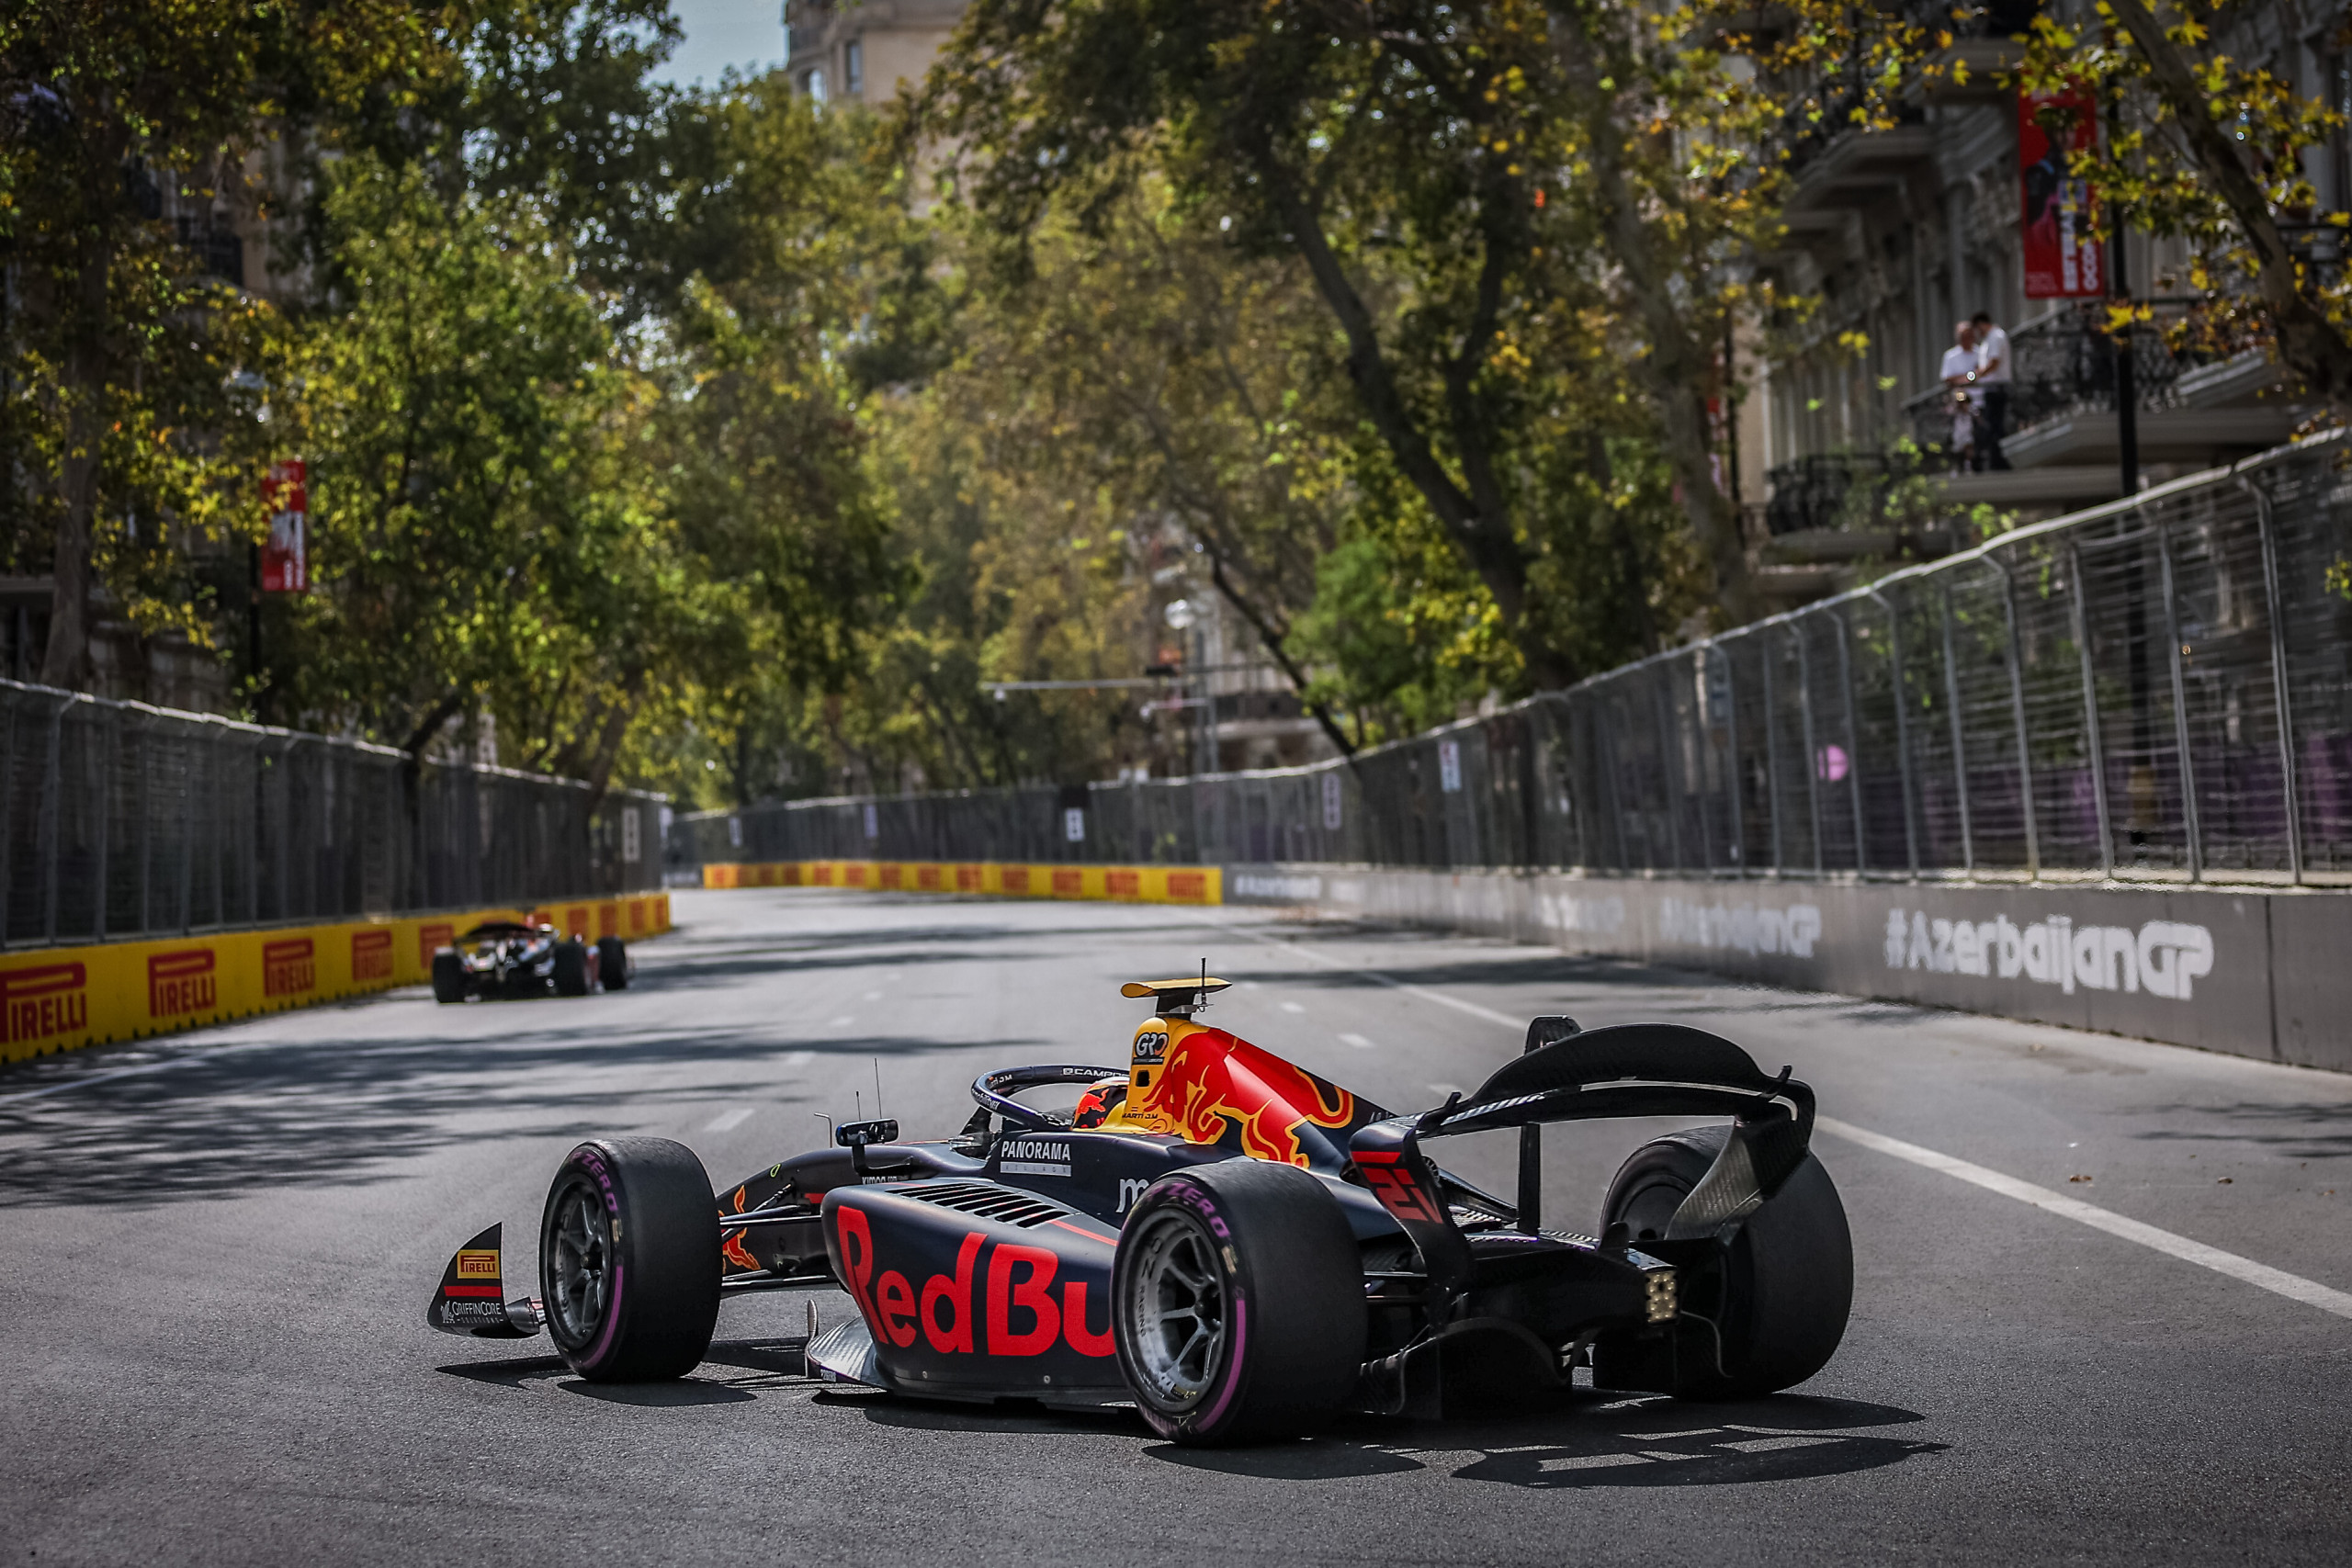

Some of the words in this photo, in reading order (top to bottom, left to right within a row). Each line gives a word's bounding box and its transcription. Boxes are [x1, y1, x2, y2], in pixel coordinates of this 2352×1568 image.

[148, 949, 216, 1017] PIRELLI
[1885, 908, 2215, 1000] #AzerbaijanGP
[0, 962, 86, 1043] PIRELLI
[1001, 1140, 1071, 1161] PANORAMA
[582, 1153, 618, 1212] ZERO
[1167, 1182, 1231, 1237] ZERO
[460, 1255, 496, 1273] PIRELLI
